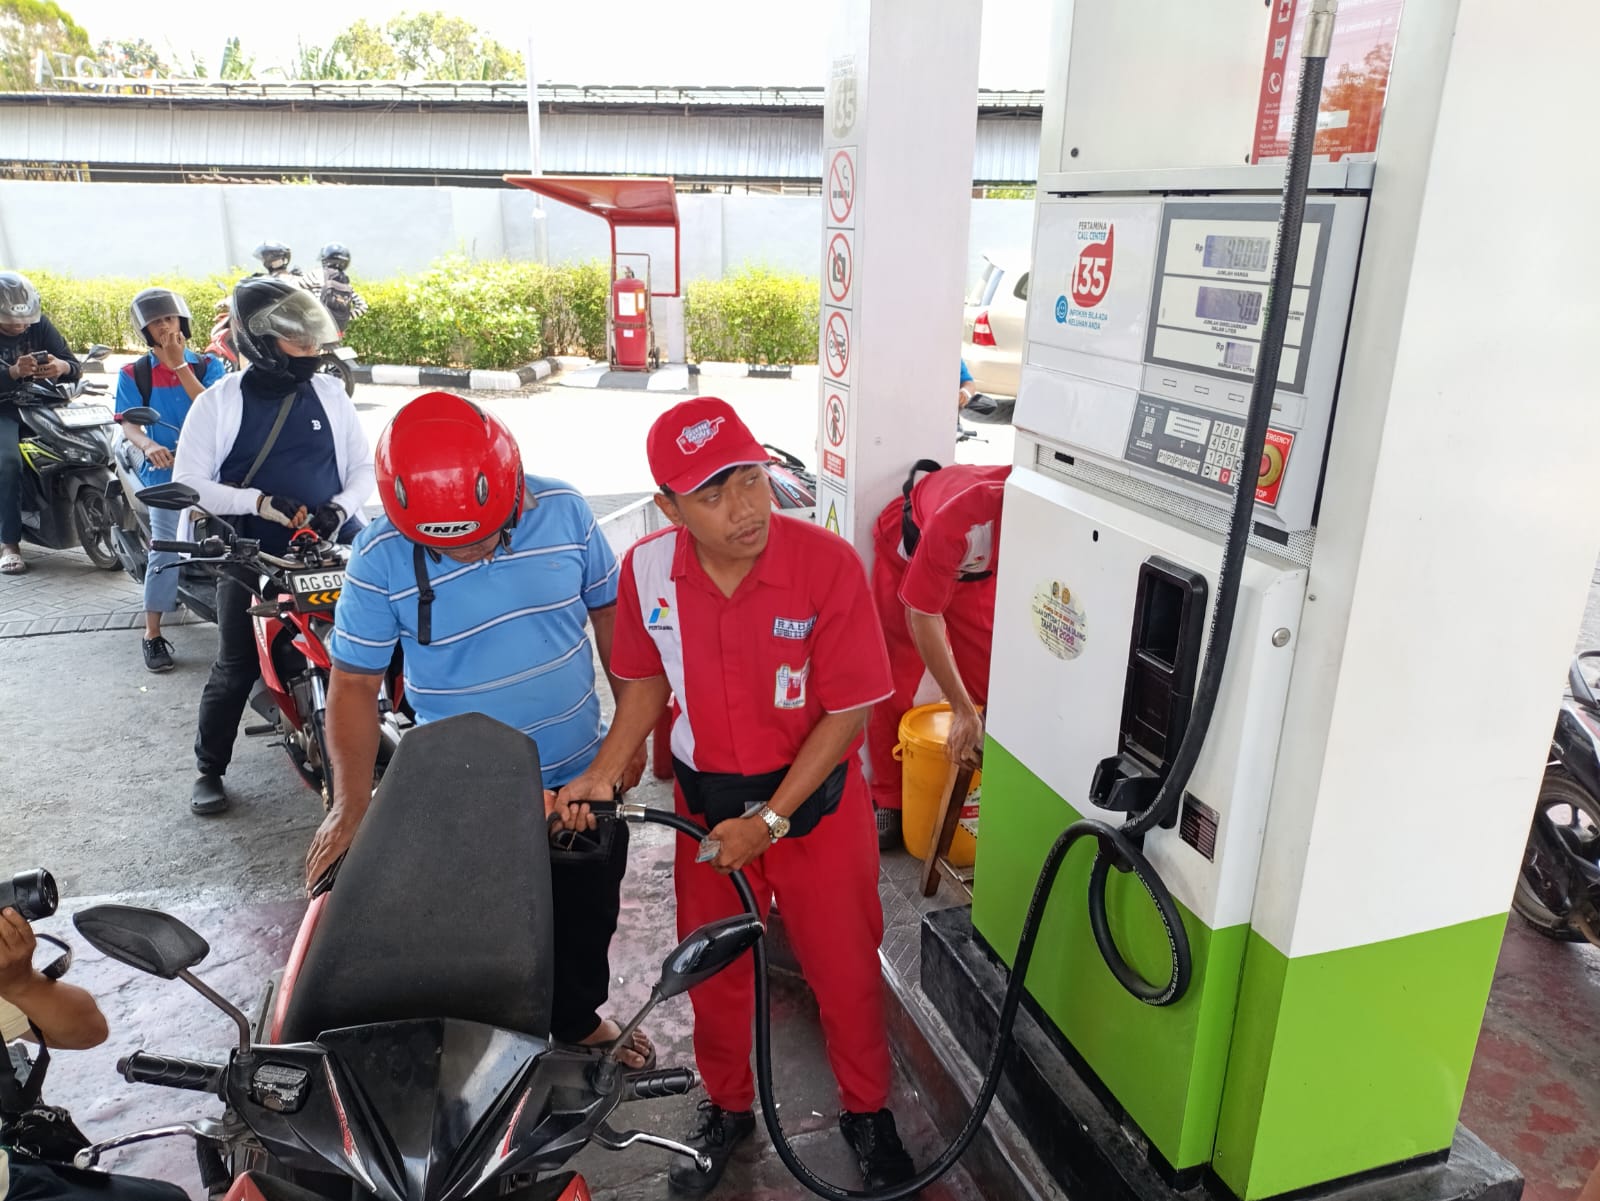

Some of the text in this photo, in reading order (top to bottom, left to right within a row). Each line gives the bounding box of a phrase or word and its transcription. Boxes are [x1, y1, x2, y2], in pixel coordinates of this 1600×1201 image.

[1078, 221, 1107, 231] PERTAMINA
[1077, 231, 1107, 241] CALL CENTER
[1195, 243, 1203, 252] Rp
[1072, 255, 1107, 296] 135
[1216, 341, 1225, 352] Rp
[1265, 432, 1291, 446] ERGENCY
[424, 523, 471, 533] INK
[299, 576, 321, 591] AG
